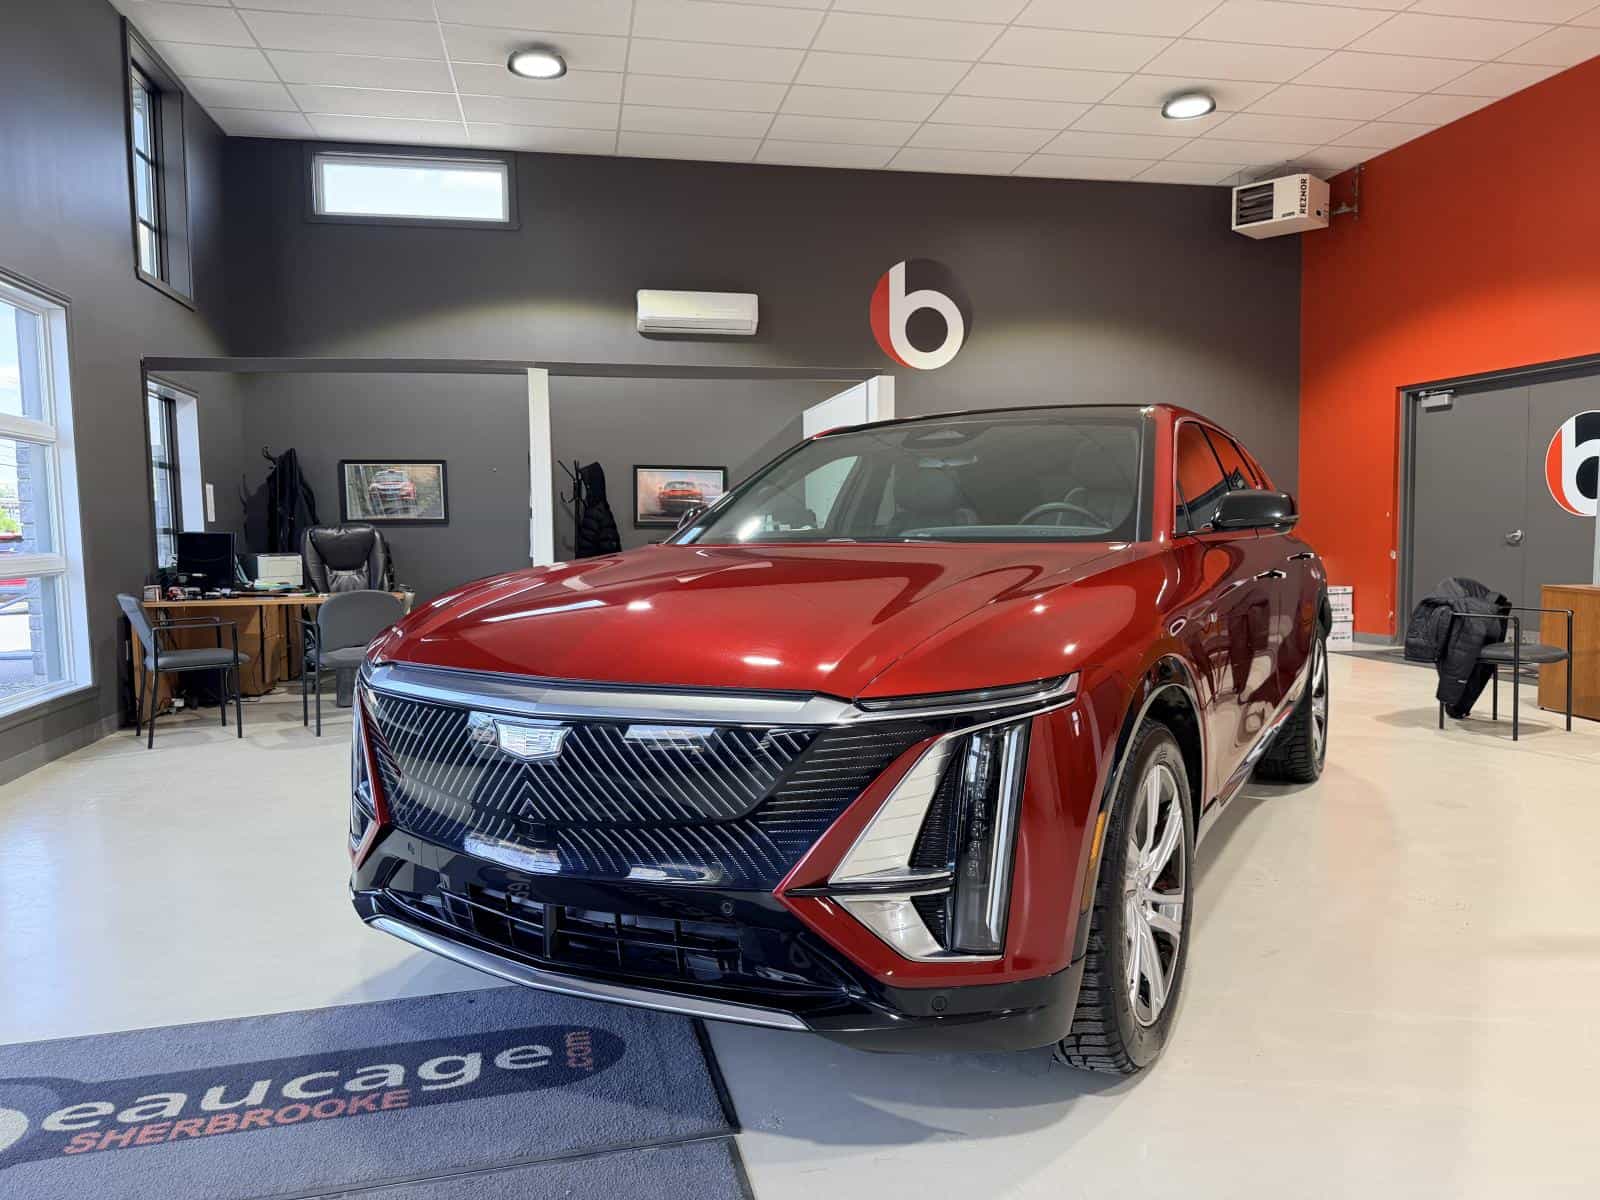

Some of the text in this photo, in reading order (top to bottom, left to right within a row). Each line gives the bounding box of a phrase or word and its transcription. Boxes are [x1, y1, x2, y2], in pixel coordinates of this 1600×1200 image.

[1300, 178, 1308, 214] REZNOR
[889, 260, 965, 370] b
[0, 1044, 553, 1152] eaucage
[63, 1088, 410, 1154] SHERBROOKE
